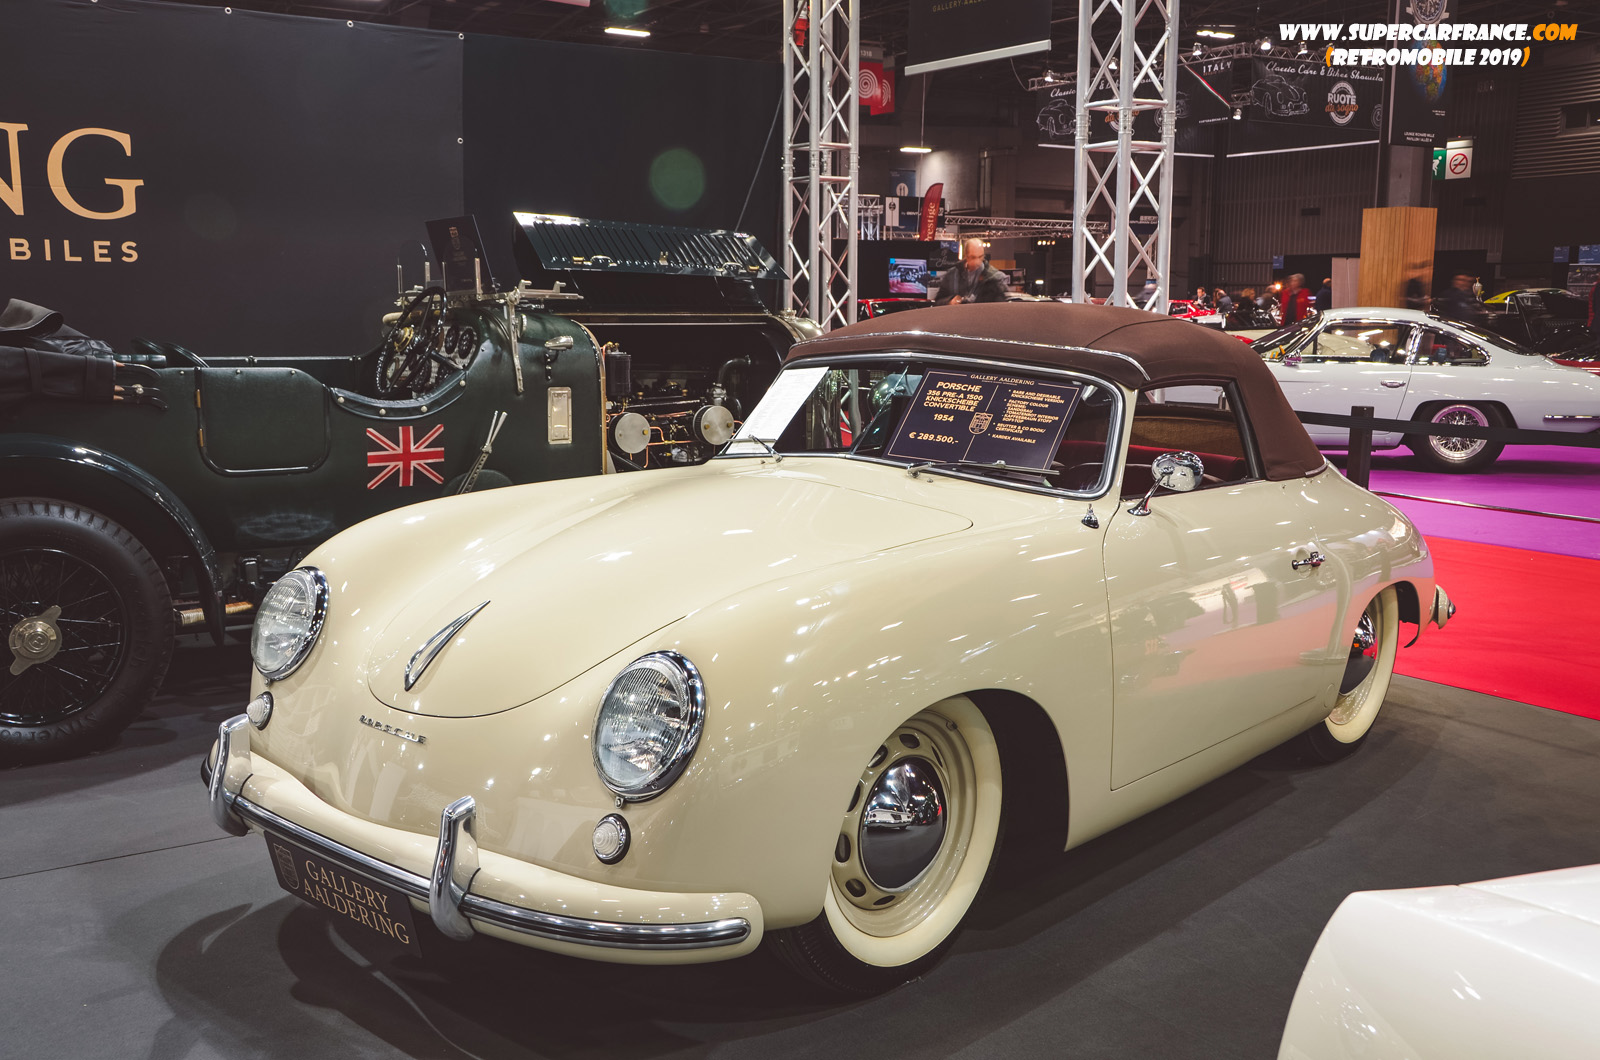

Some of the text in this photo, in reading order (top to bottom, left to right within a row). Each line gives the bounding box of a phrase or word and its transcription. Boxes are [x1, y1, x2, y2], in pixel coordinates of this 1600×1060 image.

[1202, 61, 1232, 74] ITALY
[1327, 92, 1357, 105] RUOTE
[1336, 104, 1359, 116] sogno
[970, 374, 998, 382] GALLERY
[999, 377, 1035, 386] AALDERING
[936, 381, 982, 393] PORSCHE
[925, 395, 980, 407] KNICKSCHEIBE
[926, 389, 984, 402] 356 PRE-A 1500
[923, 401, 976, 412] CONVERTIBLE
[933, 413, 955, 423] 1954
[908, 431, 960, 445] € 289.500,-
[304, 859, 390, 915] GALLERY
[303, 881, 410, 945] AALDERING
